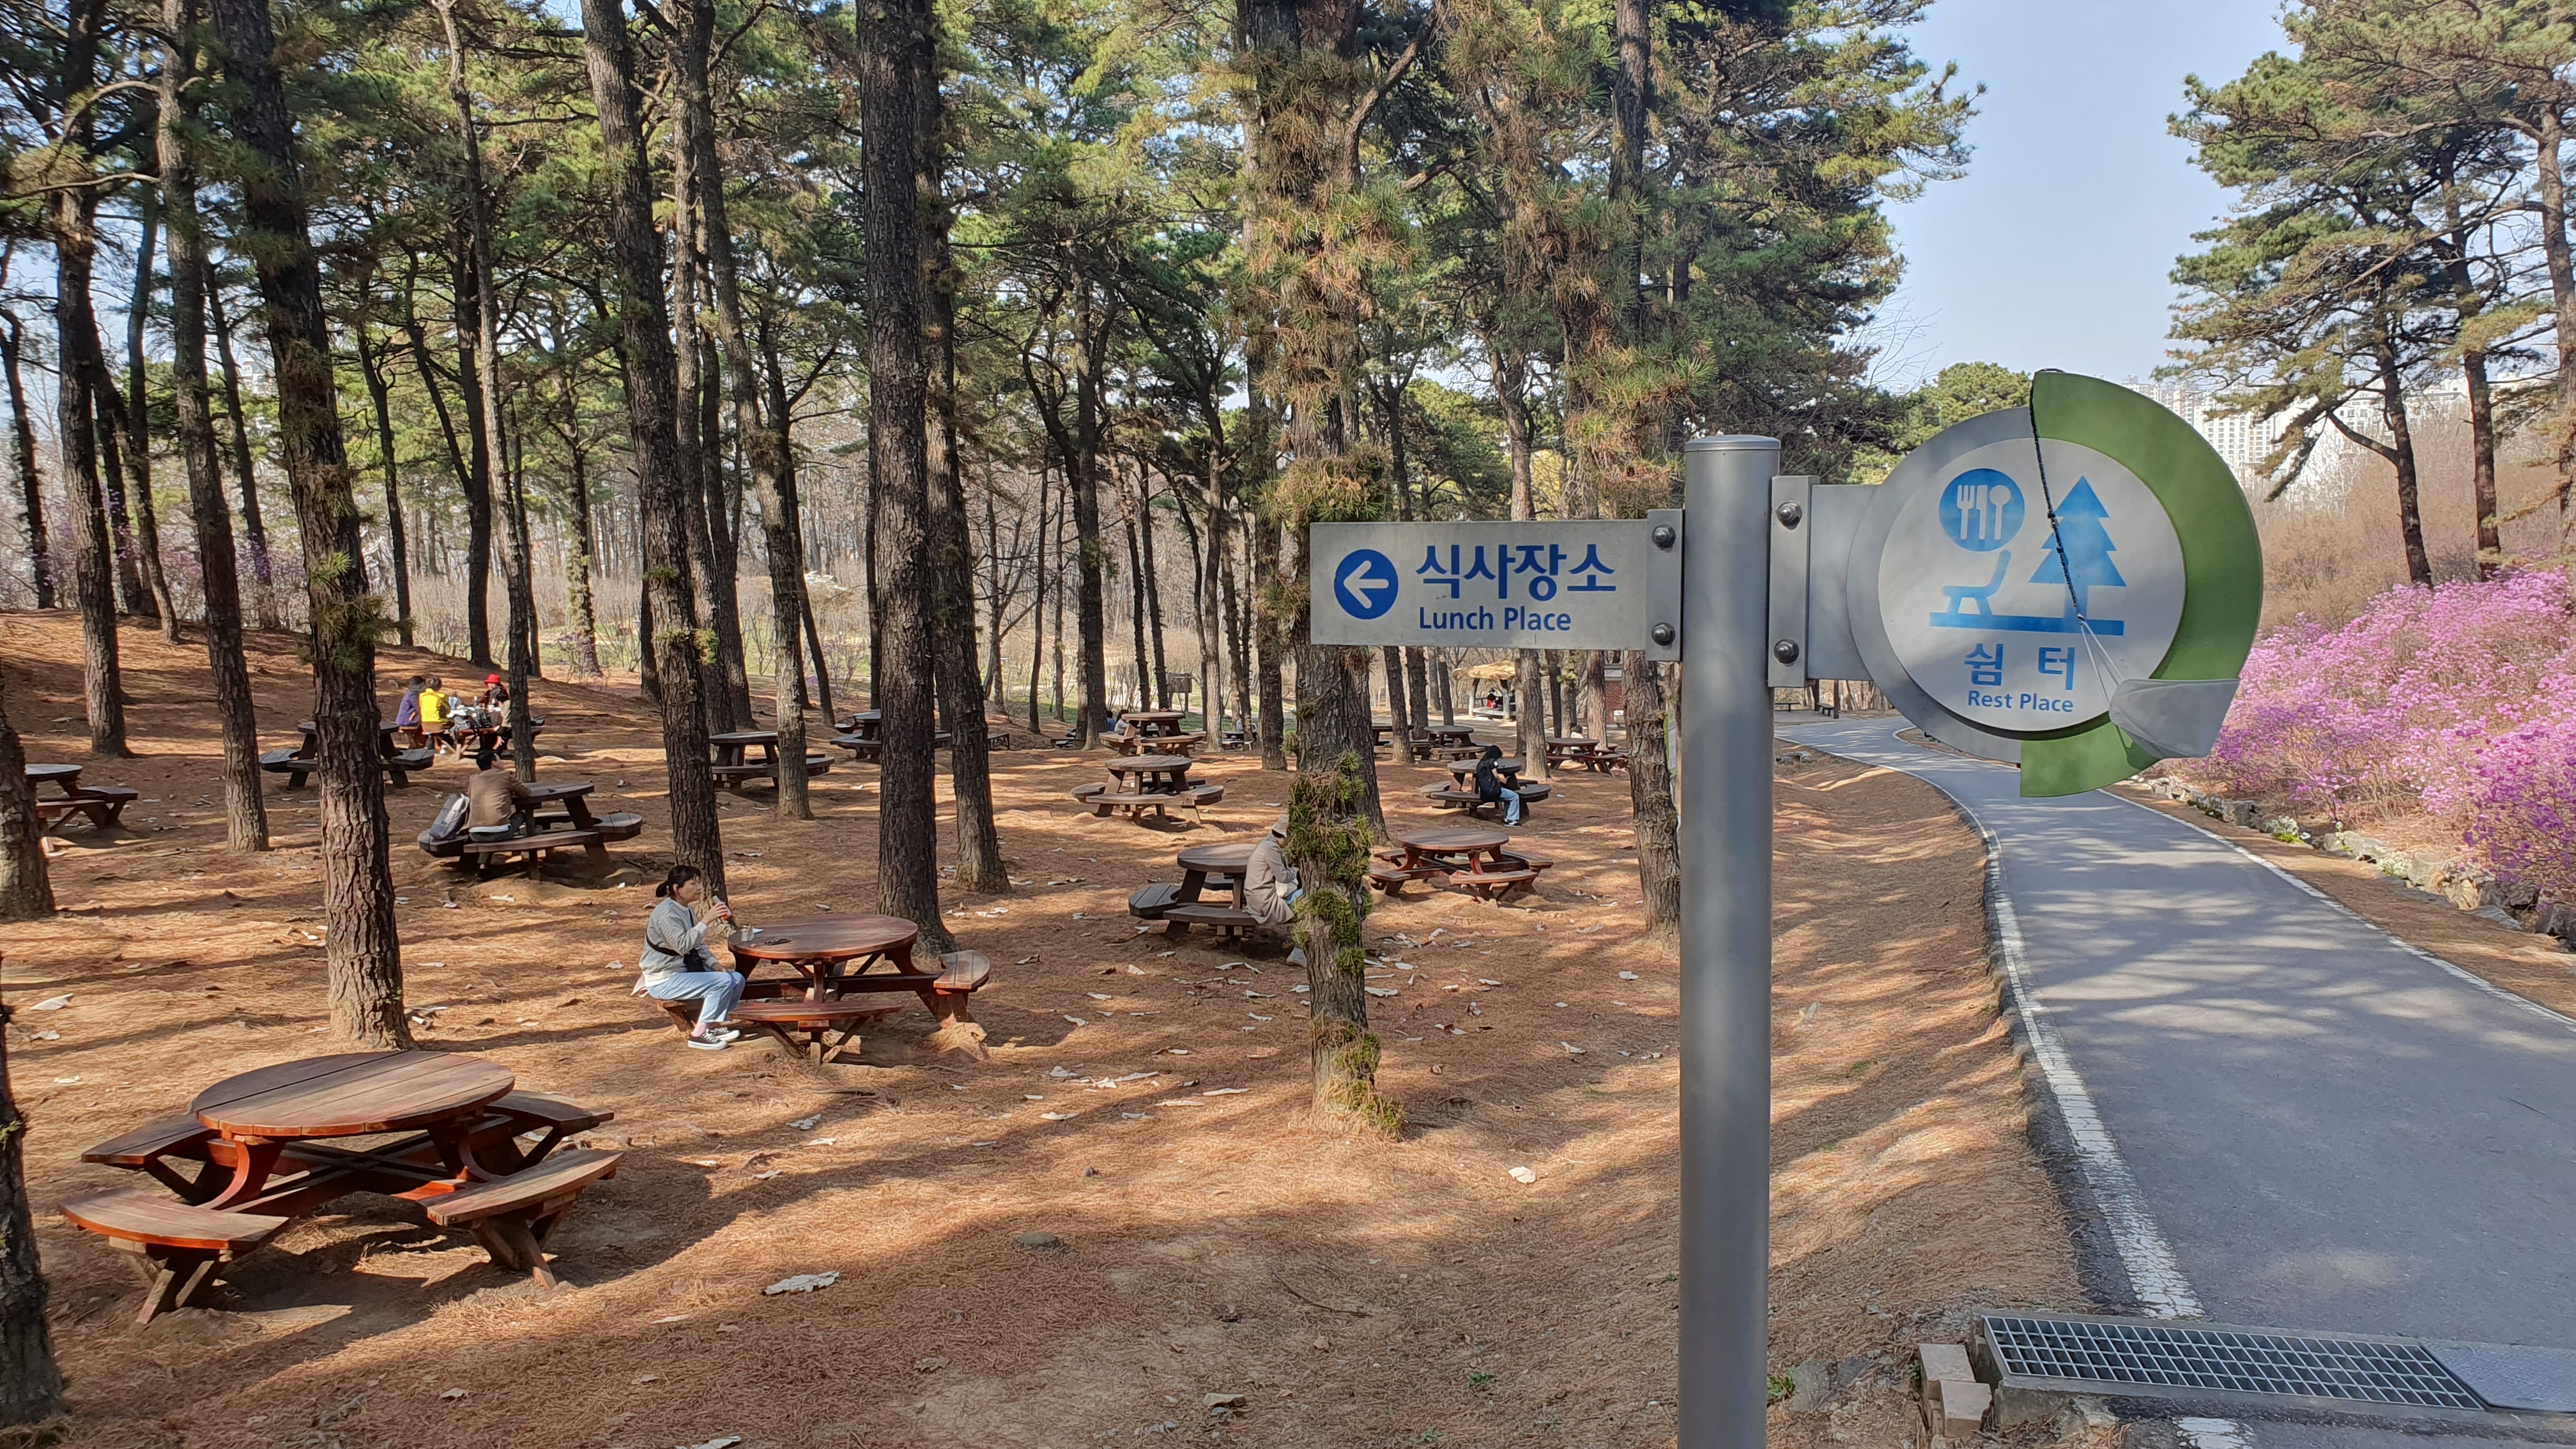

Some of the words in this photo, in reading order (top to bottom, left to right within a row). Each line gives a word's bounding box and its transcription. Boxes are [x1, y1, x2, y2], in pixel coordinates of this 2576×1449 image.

[1415, 544, 1616, 602] 식사장소
[1419, 606, 1494, 630] Lunch
[1504, 606, 1571, 631] Place
[1967, 690, 2013, 709] Rest
[2020, 693, 2074, 712] Place
